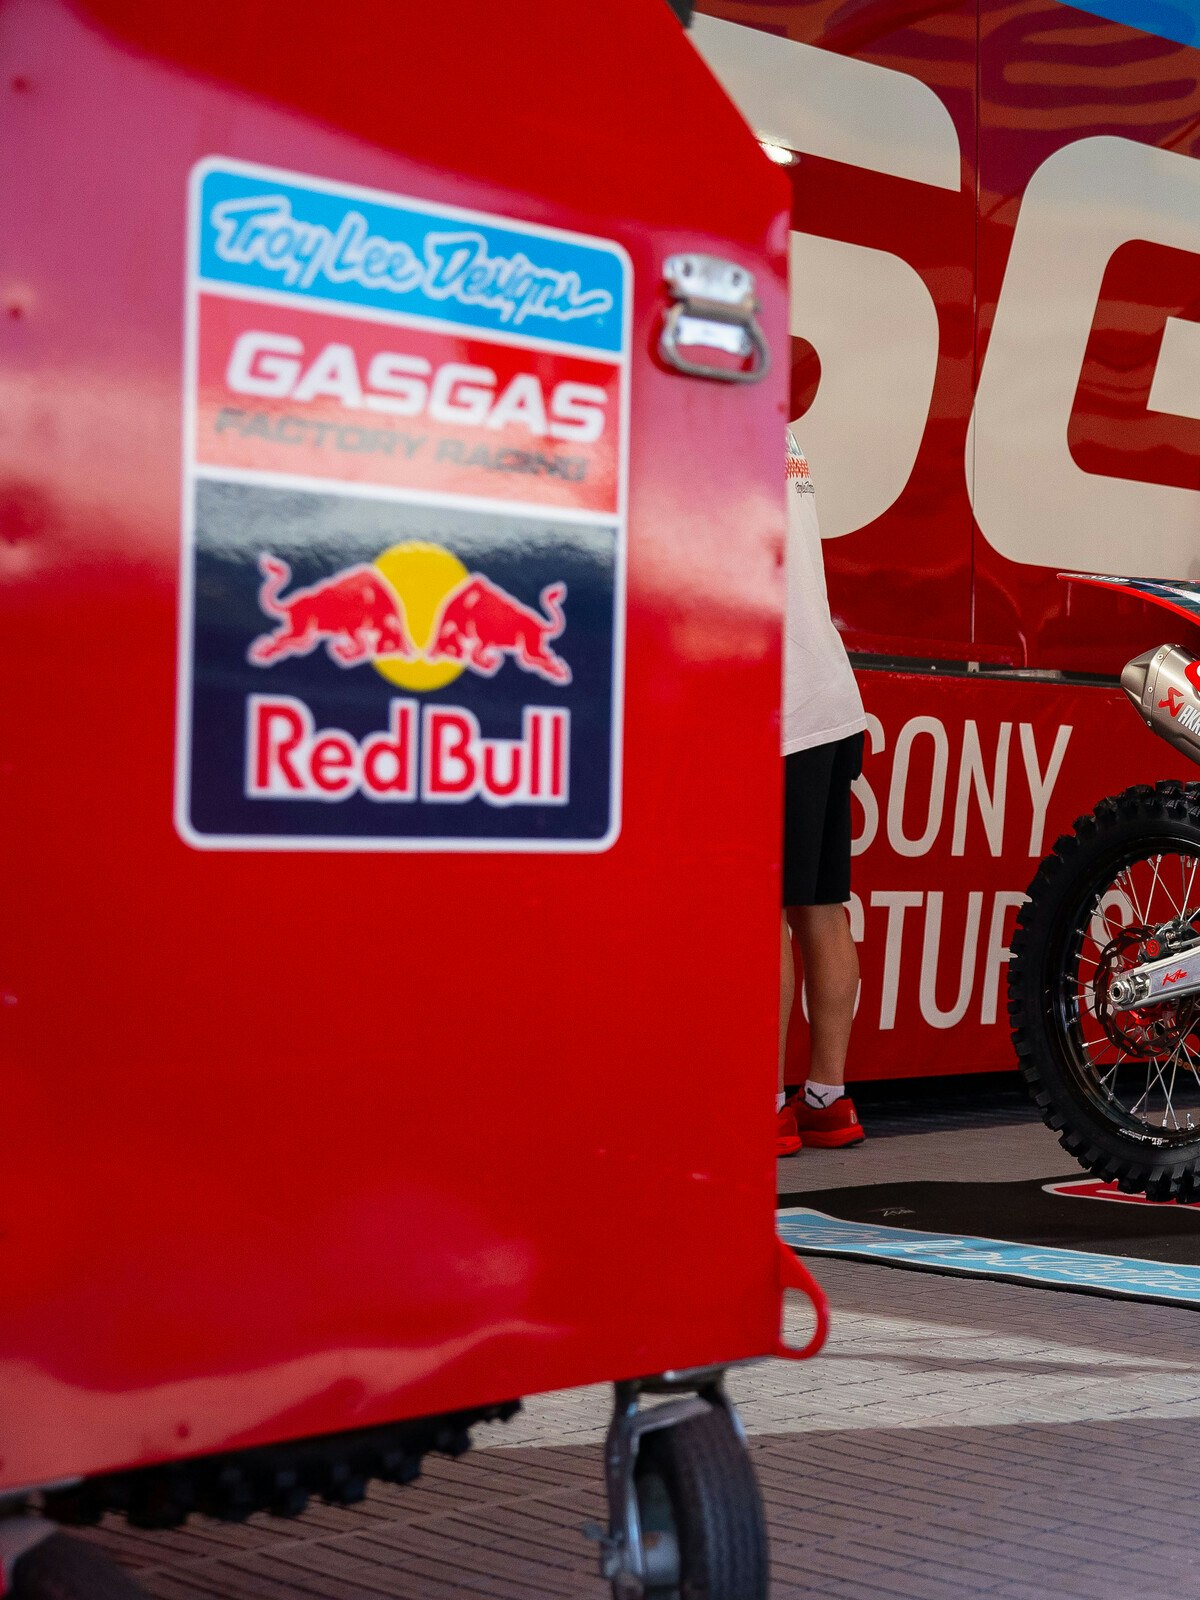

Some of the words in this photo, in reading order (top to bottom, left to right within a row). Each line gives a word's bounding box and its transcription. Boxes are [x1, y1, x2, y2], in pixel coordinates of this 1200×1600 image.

[211, 196, 325, 286] Troy
[327, 211, 423, 293] Lee
[227, 332, 608, 444] GASGAS
[213, 407, 429, 461] FACTORY
[433, 438, 589, 485] RACING
[247, 692, 418, 801] Red
[421, 704, 572, 807] Bull
[850, 713, 1073, 858] SONY
